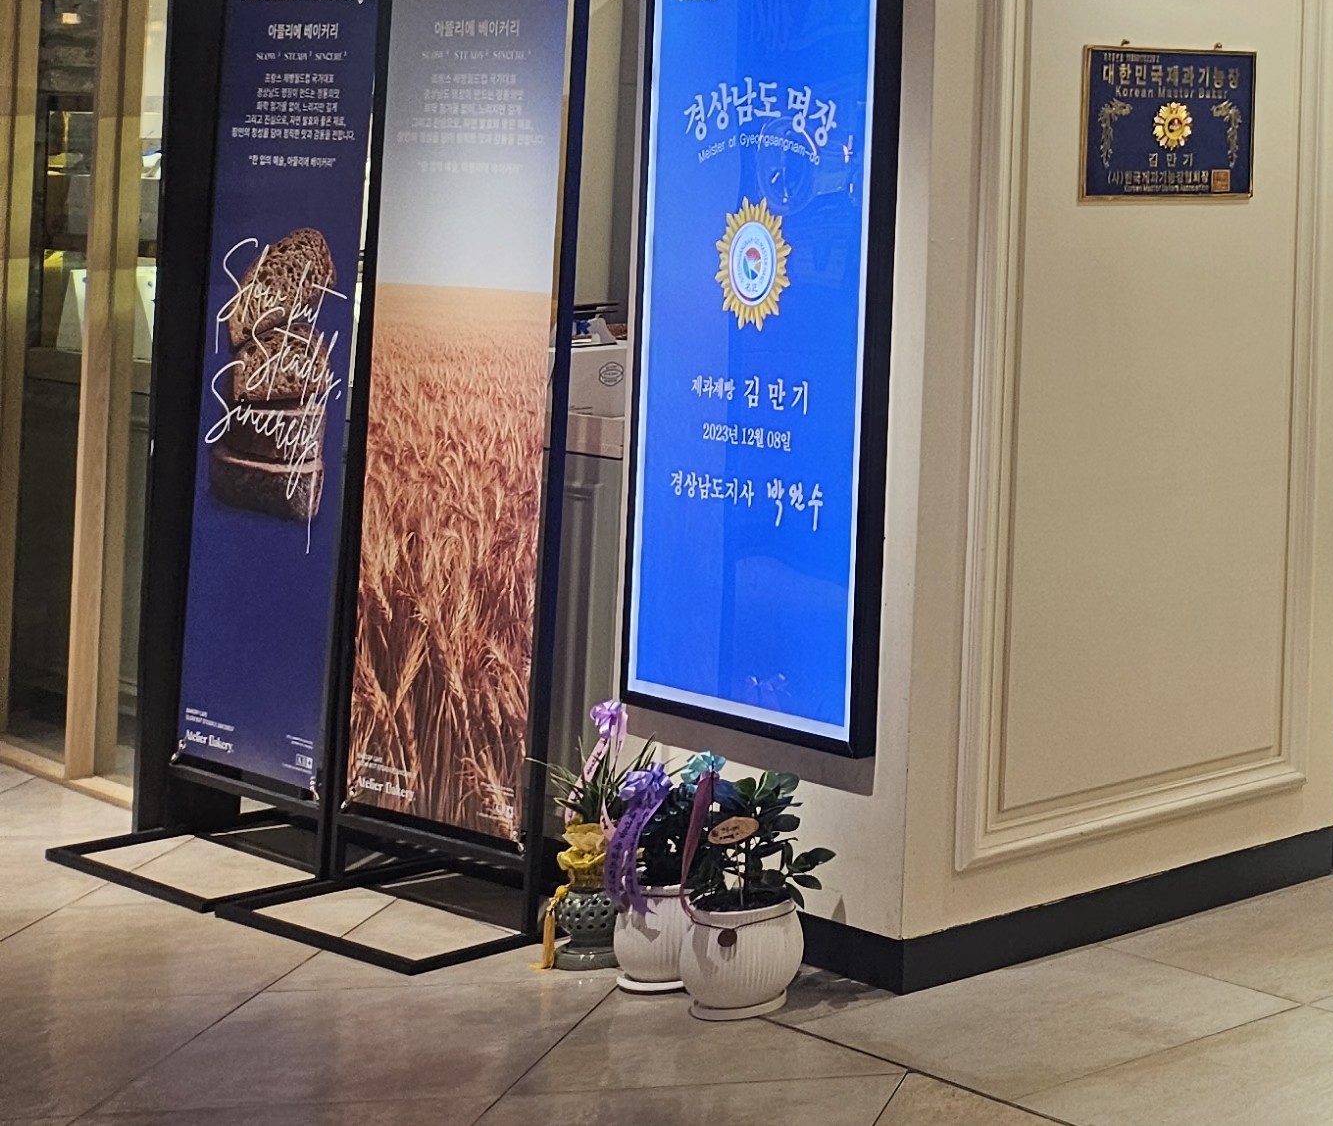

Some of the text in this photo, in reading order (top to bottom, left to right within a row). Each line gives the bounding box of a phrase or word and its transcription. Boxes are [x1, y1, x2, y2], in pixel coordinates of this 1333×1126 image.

[268, 22, 339, 40] 아뜰리에 베이커리
[434, 18, 520, 37] 아뜰리에 베이커리
[1115, 85, 1154, 98] Korean
[684, 76, 838, 147] 경상남도 명장
[698, 131, 821, 166] Meister of Gyeongsangnam-do
[691, 374, 736, 401] 제과제빵
[702, 422, 792, 452] 2023년 12월 08일
[670, 470, 755, 508] 경상남도지사
